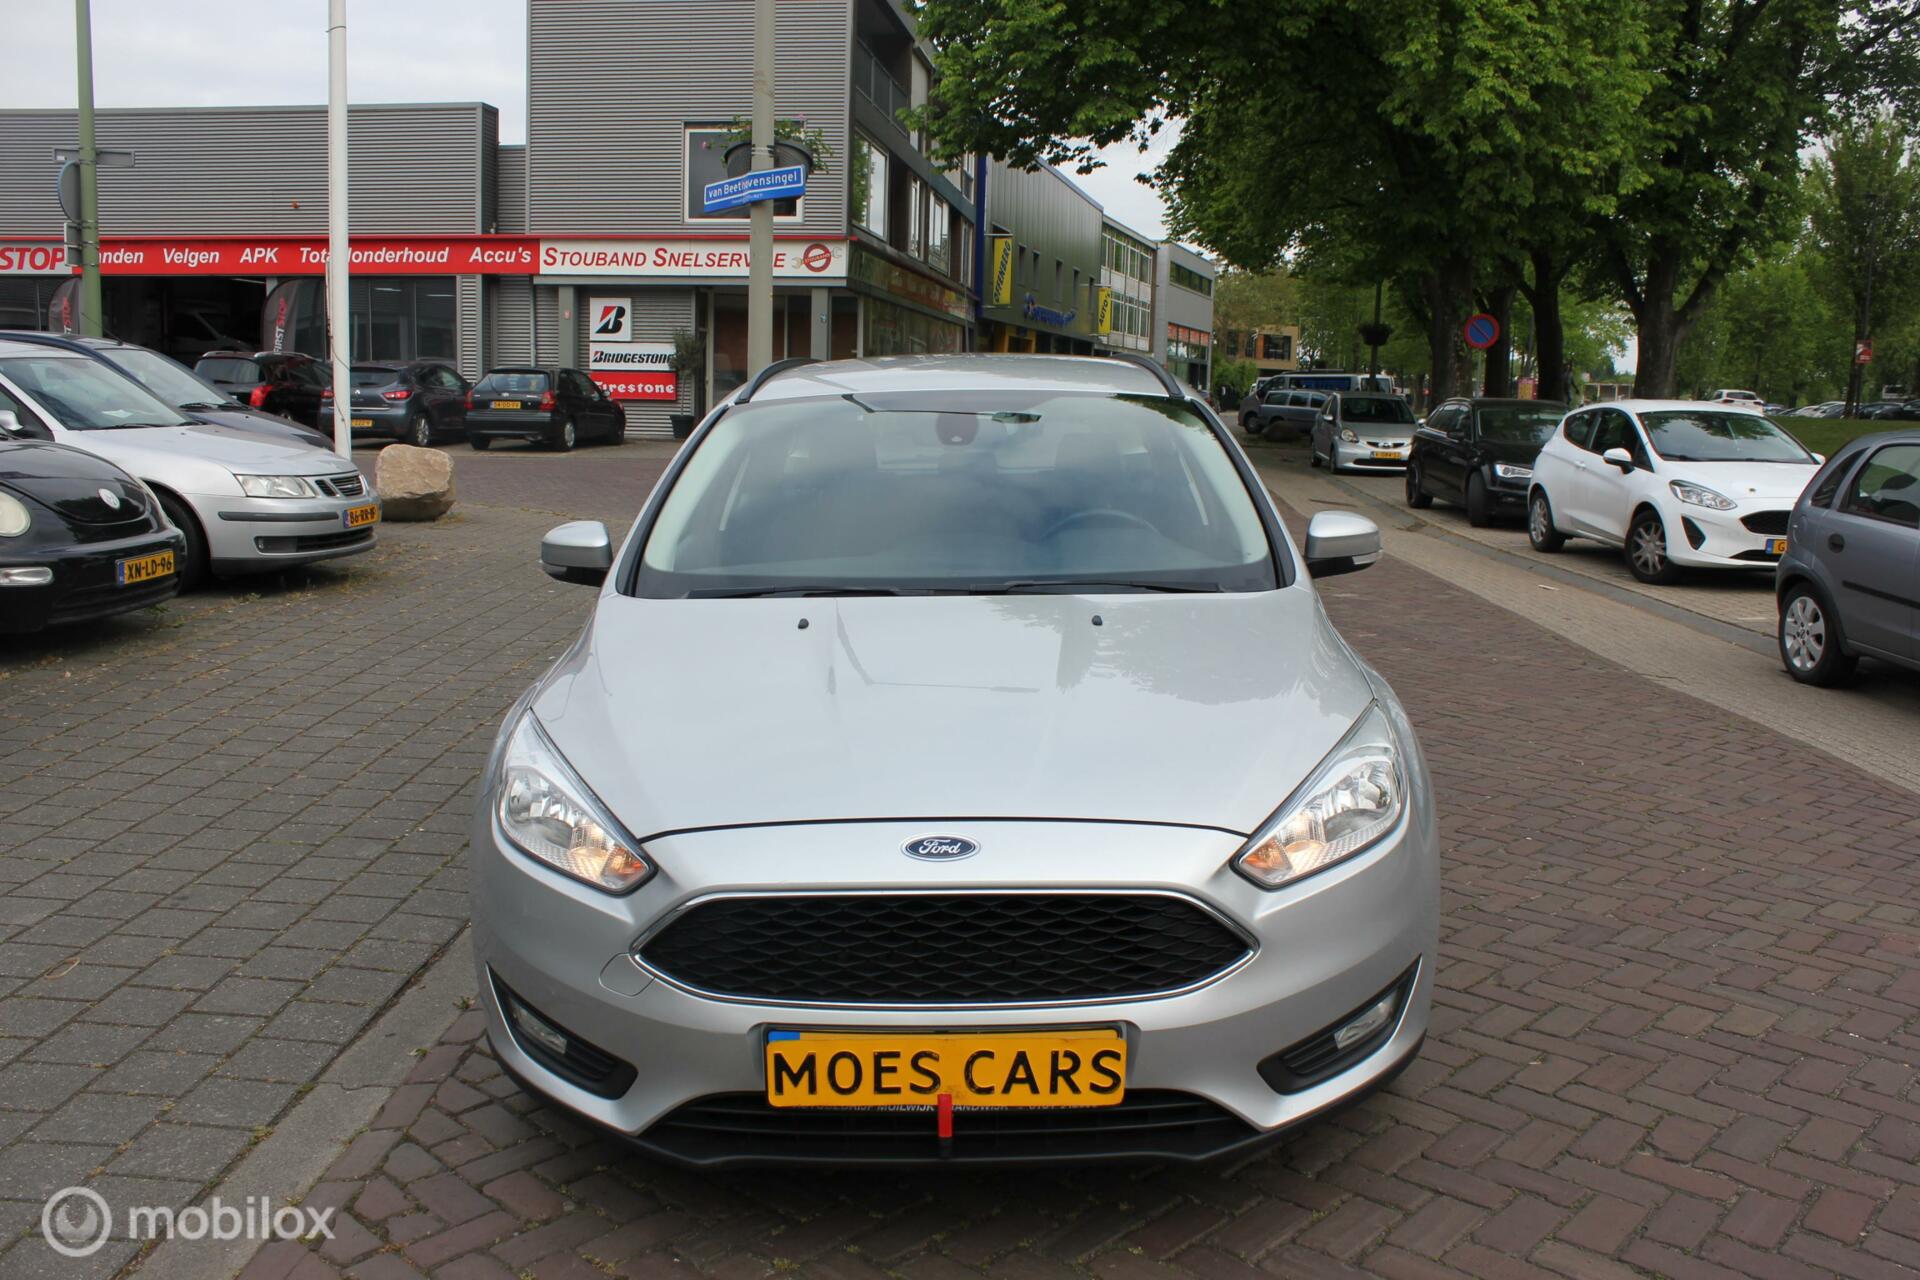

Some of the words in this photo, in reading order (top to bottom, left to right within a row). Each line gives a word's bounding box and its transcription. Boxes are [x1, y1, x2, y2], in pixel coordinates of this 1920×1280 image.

[708, 188, 722, 198] van
[0, 247, 64, 270] STOP
[99, 248, 144, 264] nden
[163, 248, 220, 267] Velgen
[240, 248, 279, 264] APK
[300, 247, 449, 263] Totlonderhoud
[469, 247, 532, 263] Accu's
[543, 247, 647, 267] STOUBAND
[652, 248, 786, 268] SNELSERVE
[127, 555, 172, 581] XN-LD-96
[919, 839, 961, 854] Ford
[773, 1051, 941, 1096] MOES
[964, 1050, 1122, 1095] CARS
